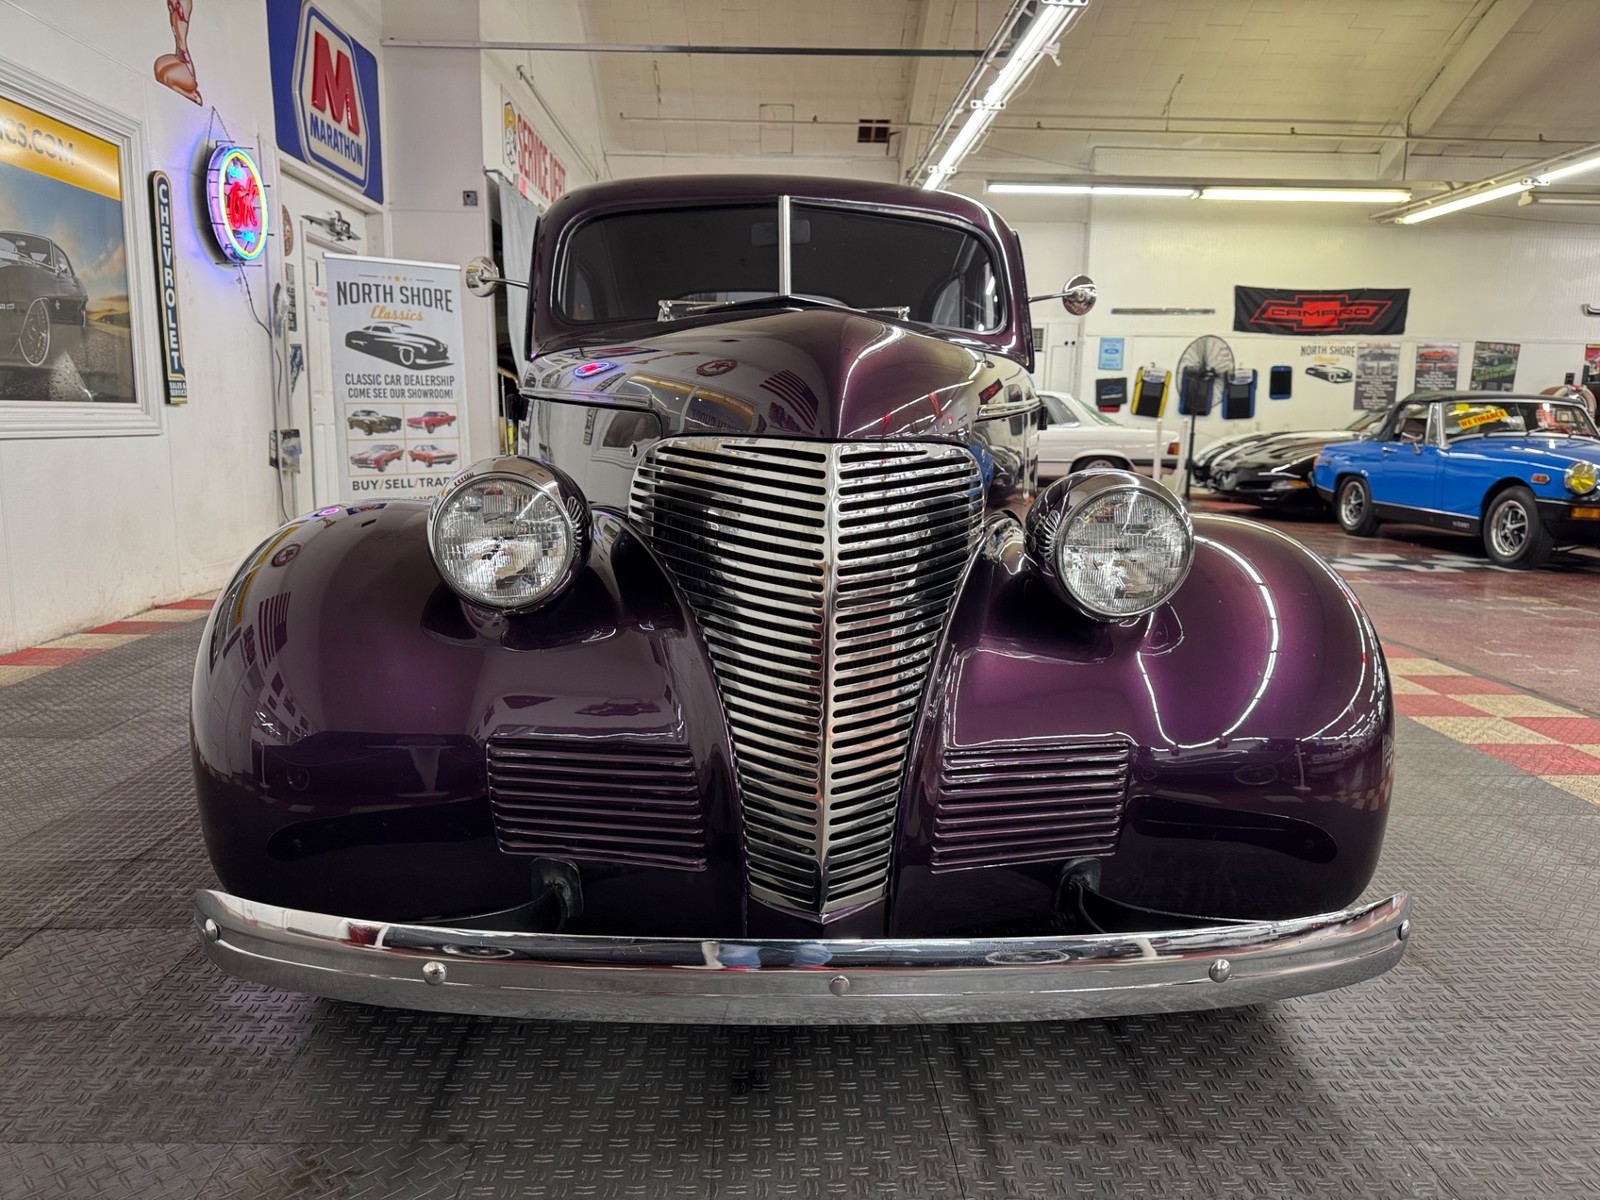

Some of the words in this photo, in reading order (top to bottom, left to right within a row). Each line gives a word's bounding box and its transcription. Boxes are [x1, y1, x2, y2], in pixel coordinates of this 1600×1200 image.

[311, 30, 360, 138] M
[309, 112, 364, 167] MARATHON
[517, 112, 549, 199] SERVICE
[158, 183, 181, 370] CHEVROLET
[336, 281, 394, 306] NORTH
[399, 285, 454, 313] SHORE
[369, 305, 424, 321] Classics
[1271, 308, 1370, 317] CAMARO
[1300, 345, 1328, 357] NORTH
[1329, 345, 1356, 357] SHORE
[345, 373, 382, 386] CLASSIC
[384, 374, 402, 386] CAR
[404, 375, 455, 387] DEALERSHIP
[348, 388, 371, 399] COME
[373, 388, 388, 399] SEE
[390, 388, 406, 399] OUR
[407, 388, 454, 399] SHOWROOM!
[1460, 419, 1472, 427] WE
[1473, 411, 1505, 424] FINANCE
[352, 477, 451, 491] BUY/SELL/TRA
